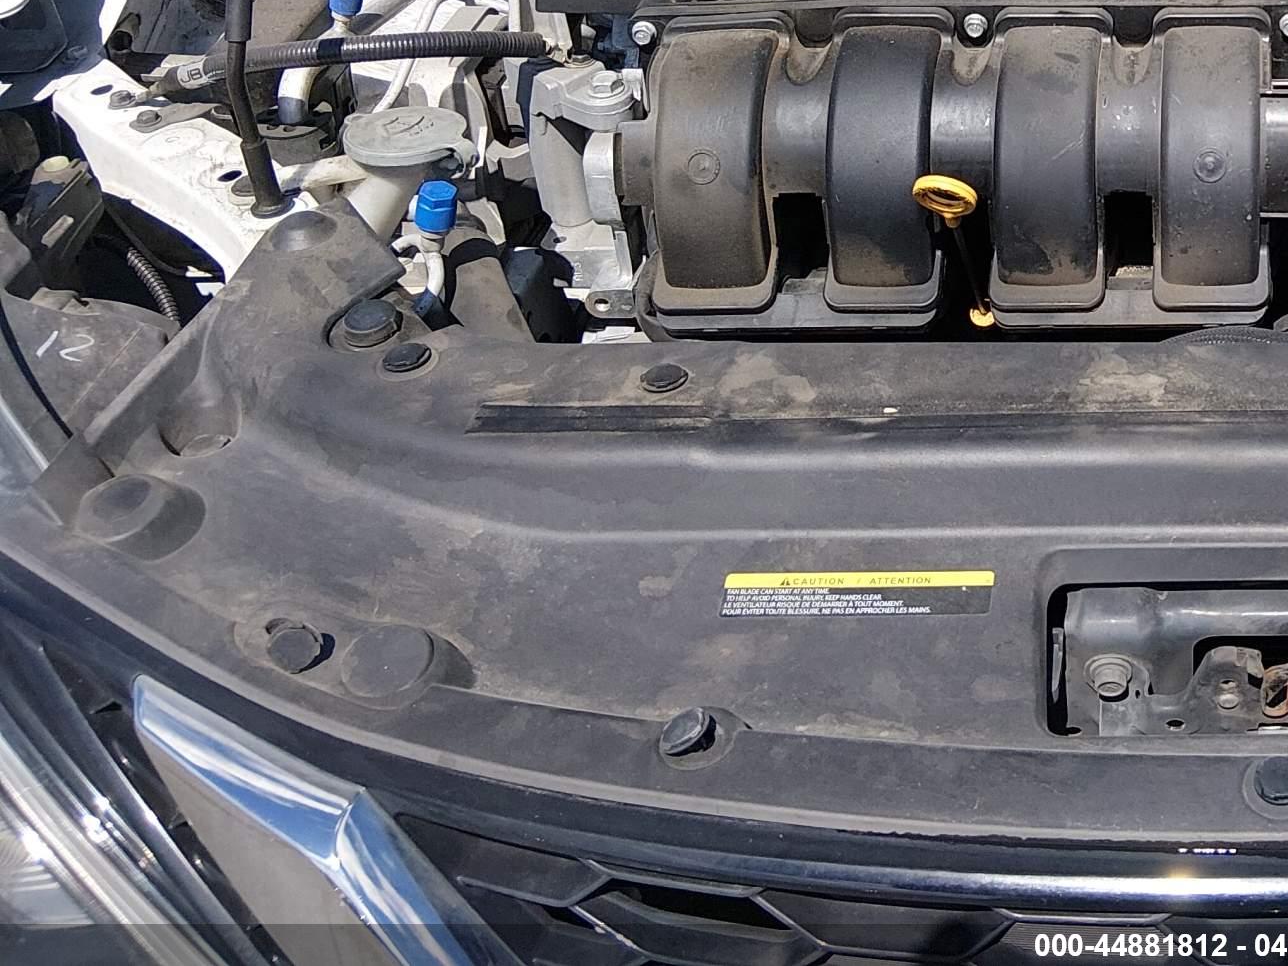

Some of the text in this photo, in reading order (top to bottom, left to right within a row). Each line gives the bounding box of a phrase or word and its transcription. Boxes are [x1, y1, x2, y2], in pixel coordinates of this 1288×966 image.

[793, 577, 844, 585] CAUTION
[870, 577, 931, 585] ATTENTION
[721, 608, 741, 616] POUR
[895, 606, 907, 614] LES
